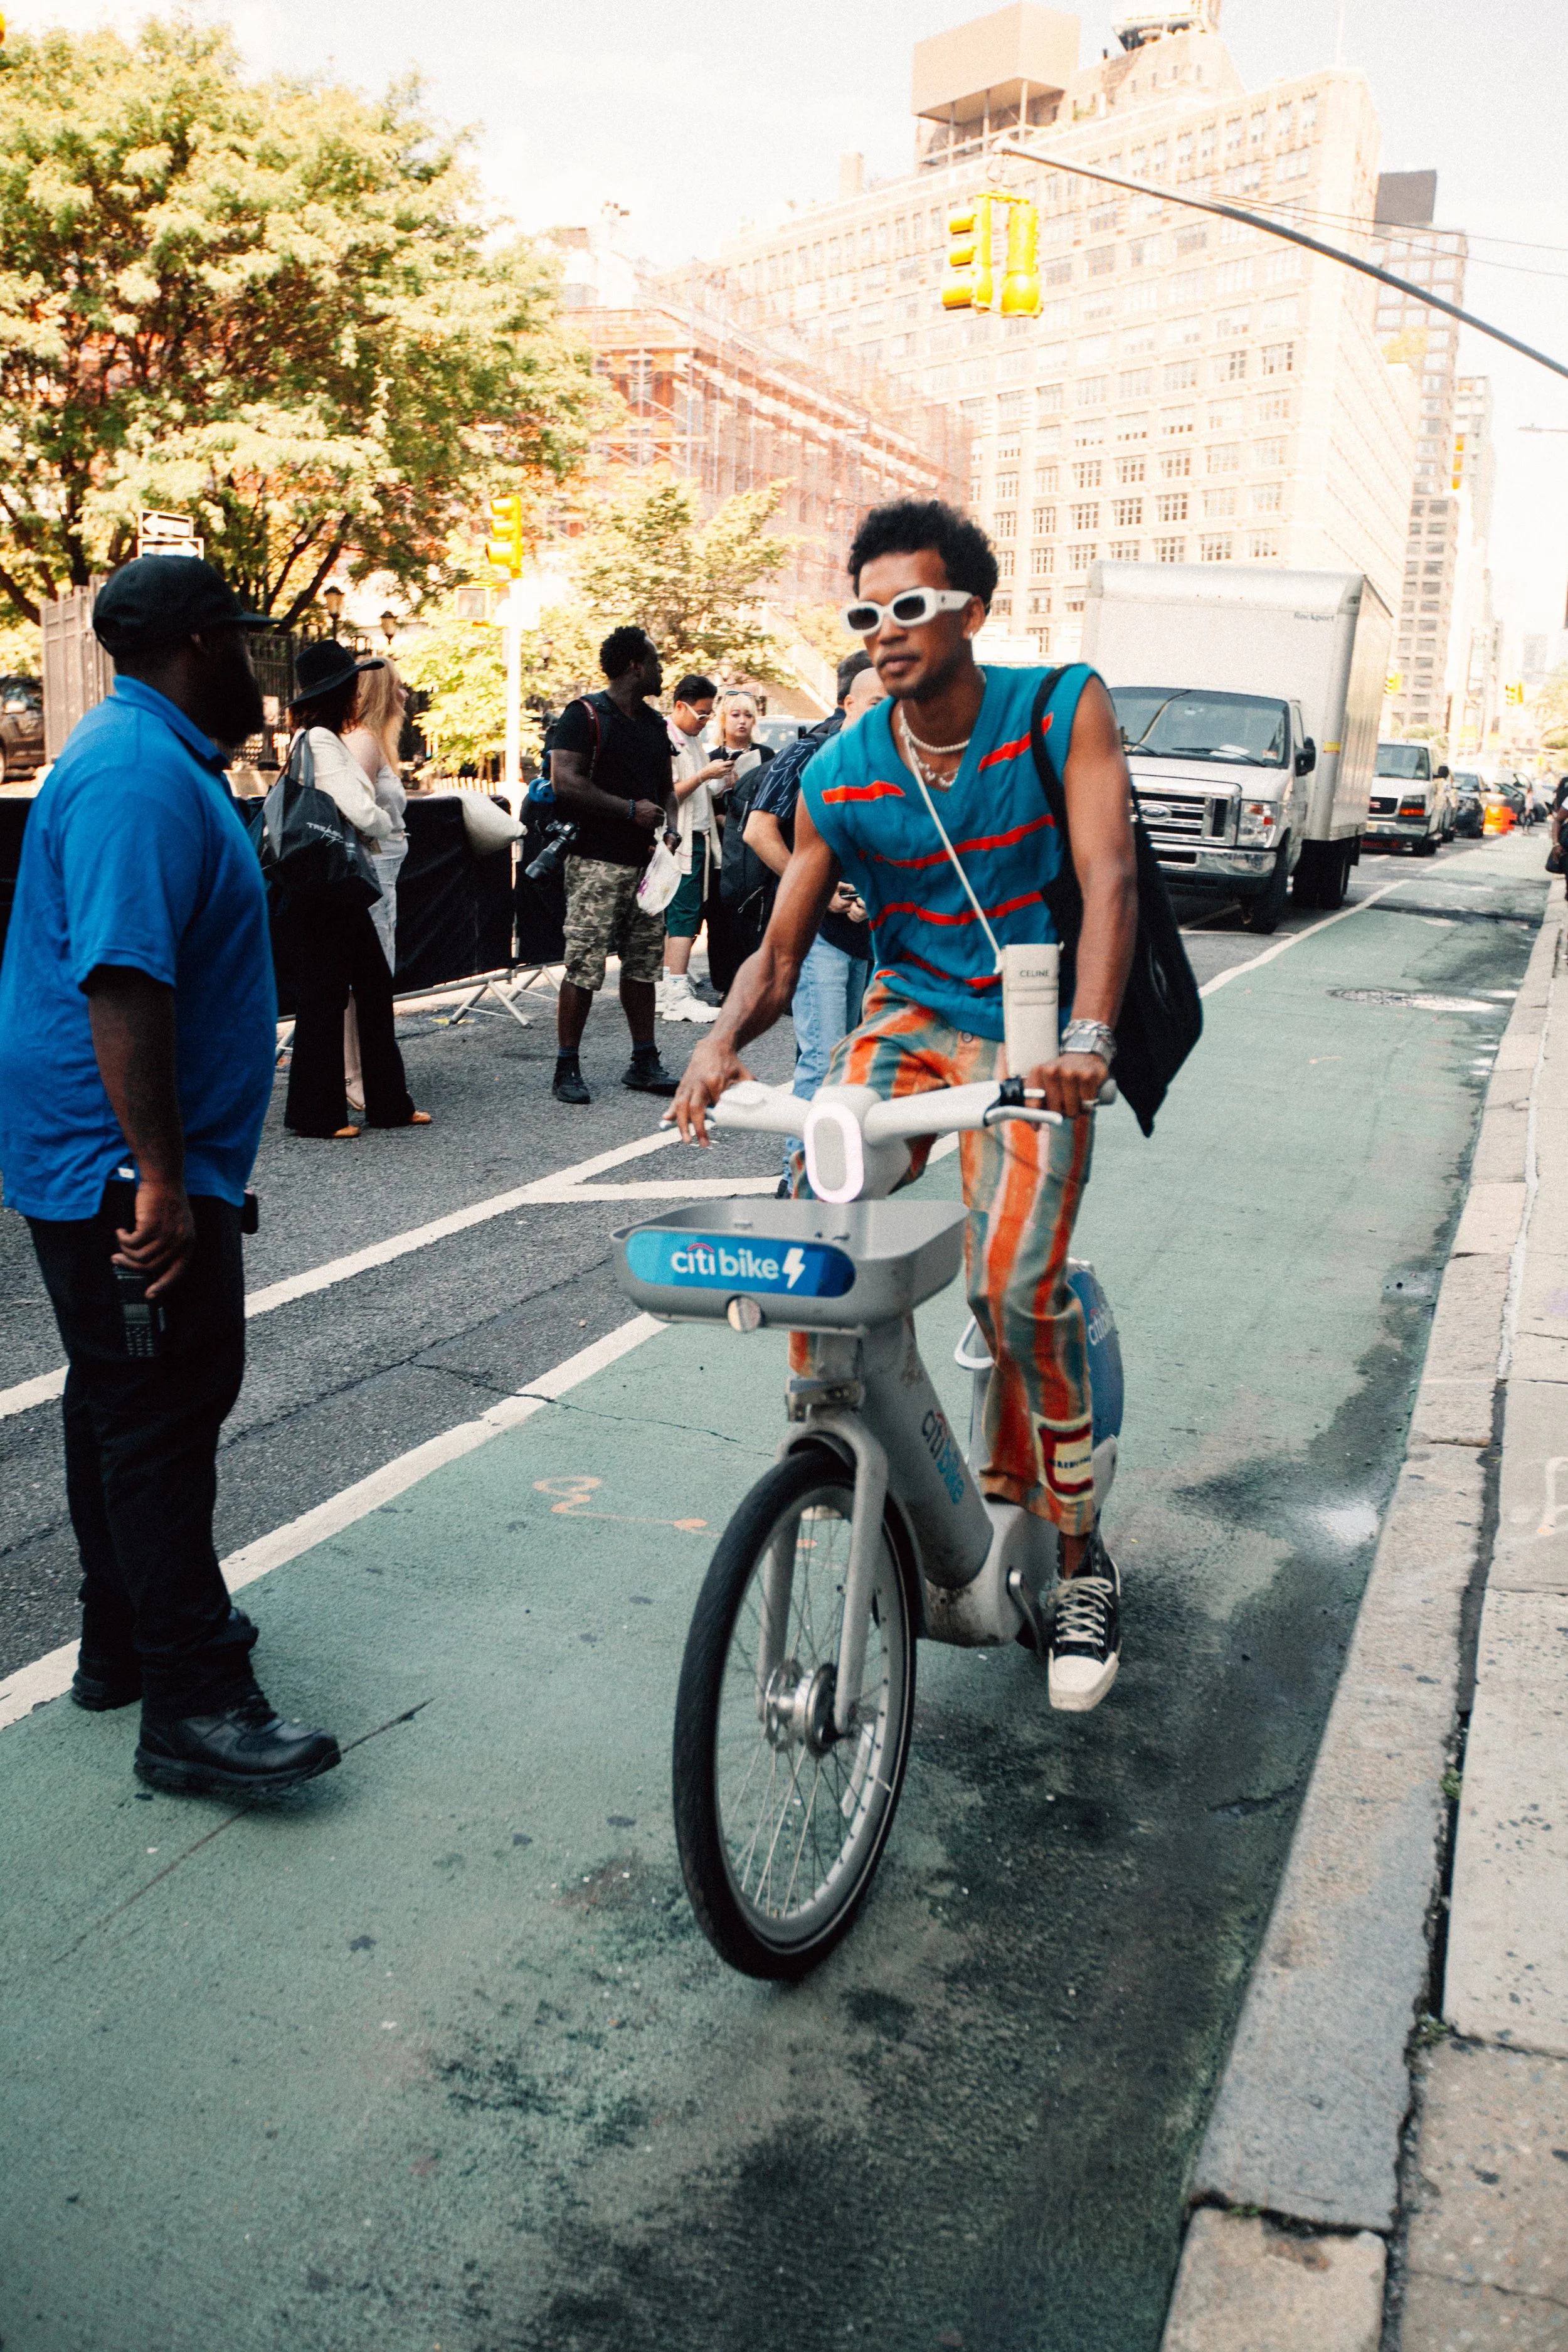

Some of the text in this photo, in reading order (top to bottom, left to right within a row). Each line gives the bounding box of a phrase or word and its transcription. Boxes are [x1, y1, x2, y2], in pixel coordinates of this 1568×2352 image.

[1294, 612, 1334, 622] Rockport
[670, 1242, 780, 1280] citi bike
